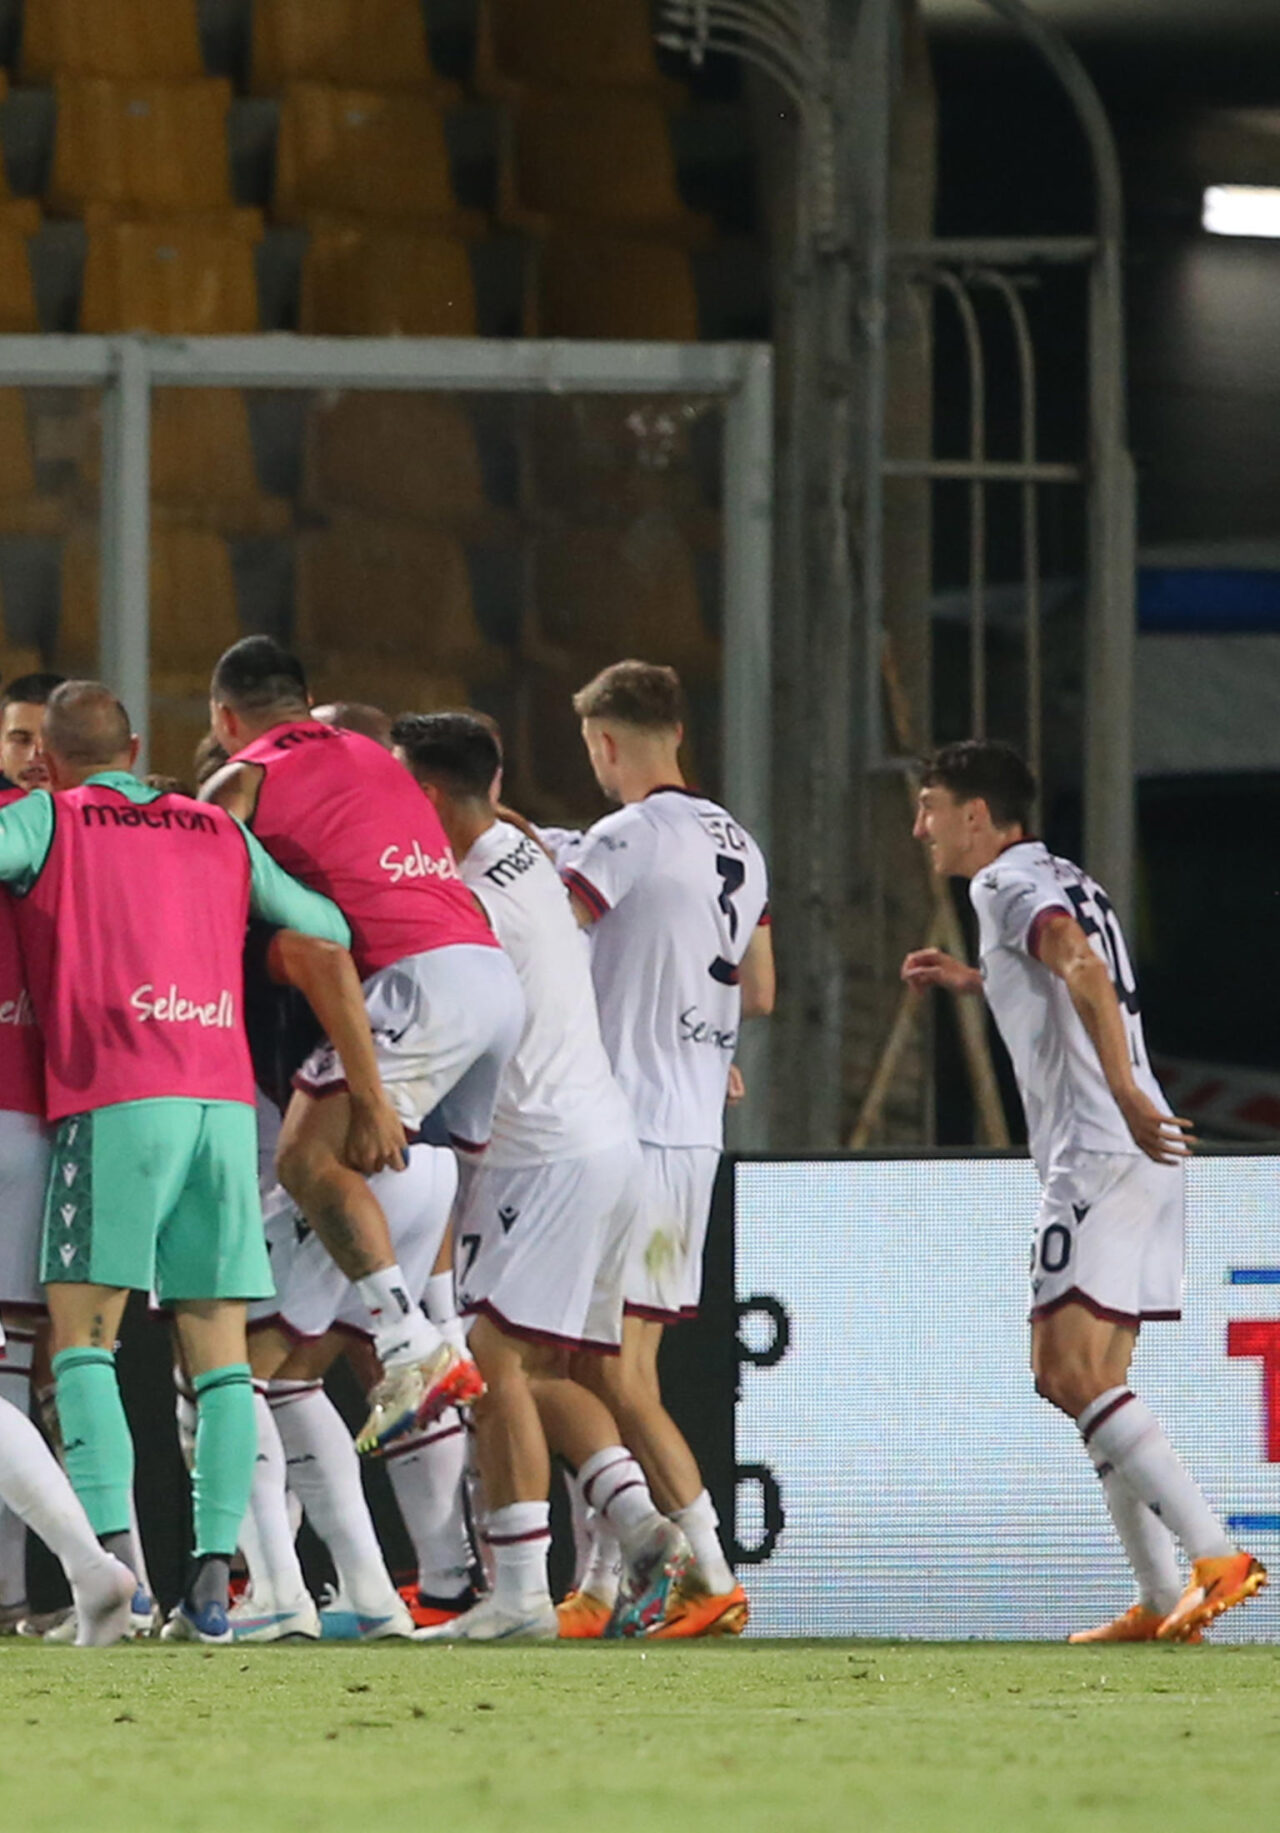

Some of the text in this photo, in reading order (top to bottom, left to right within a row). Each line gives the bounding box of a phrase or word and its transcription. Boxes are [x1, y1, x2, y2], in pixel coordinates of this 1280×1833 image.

[82, 804, 219, 835] macron
[708, 854, 745, 986] 3
[130, 983, 234, 1028] Selenell
[460, 1233, 482, 1286] 7
[1030, 1222, 1071, 1274] 0
